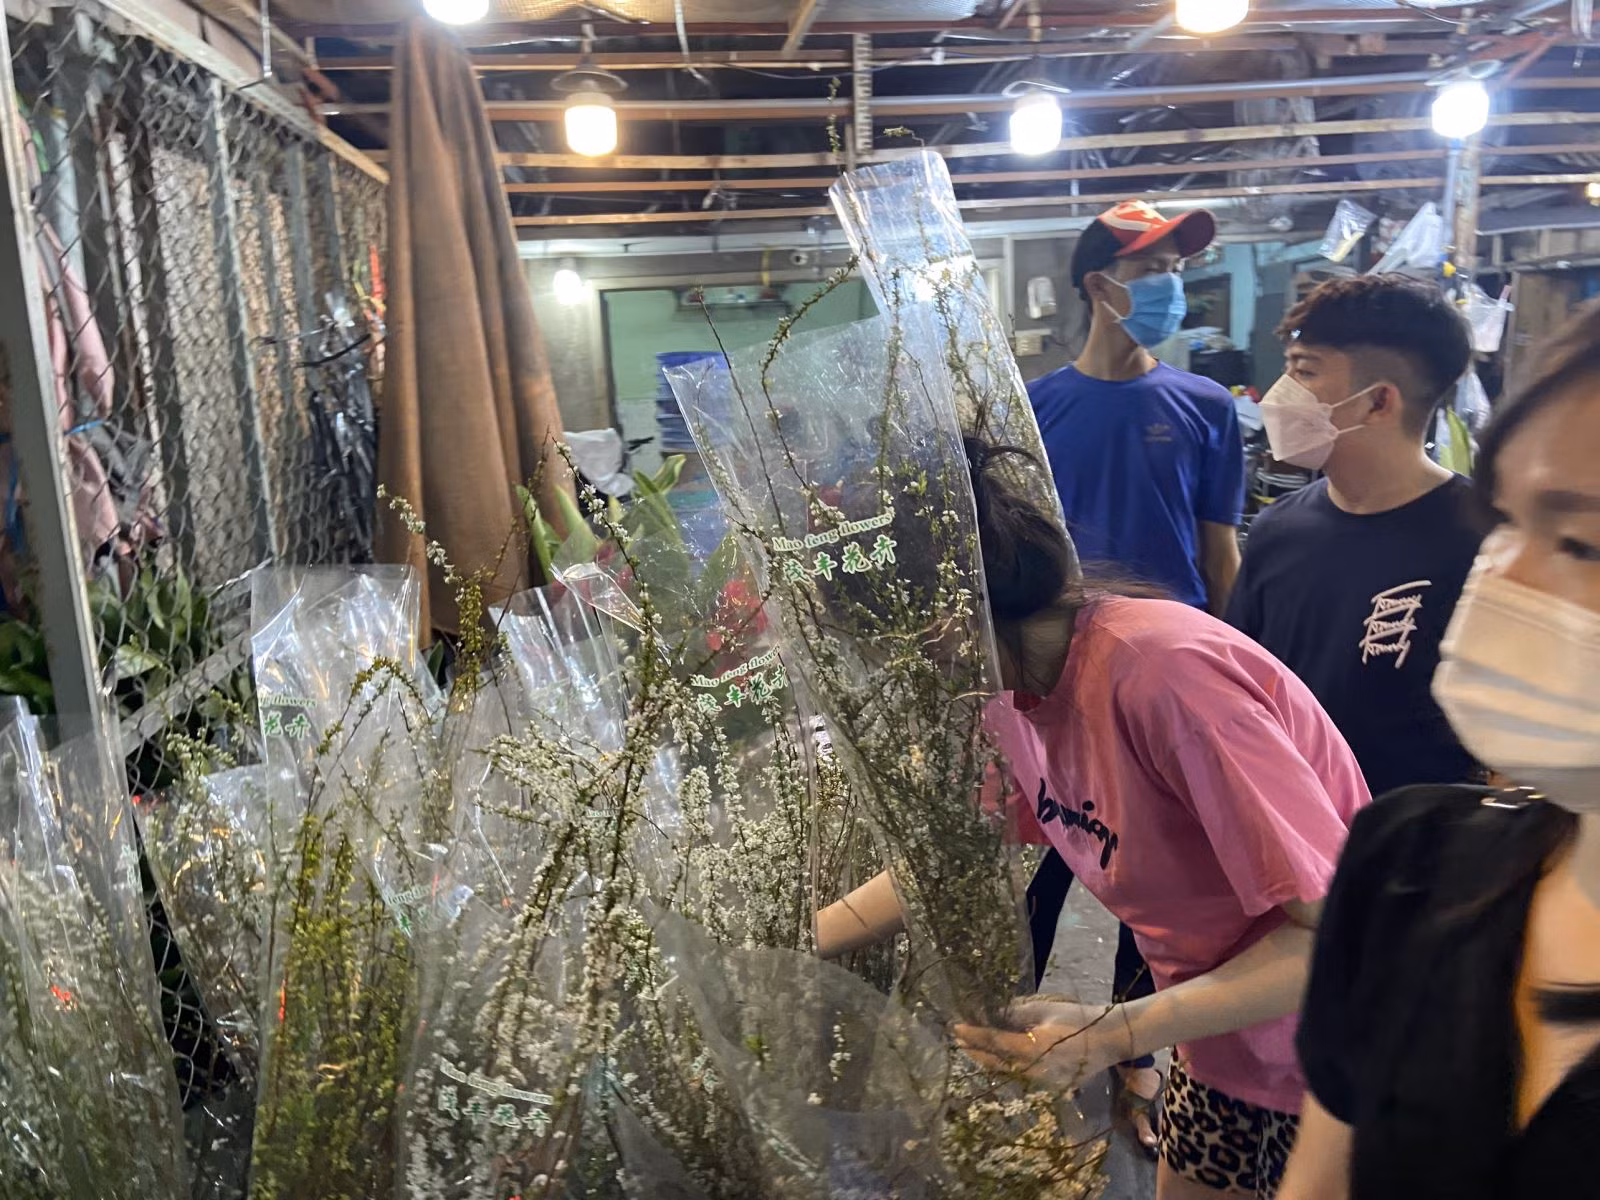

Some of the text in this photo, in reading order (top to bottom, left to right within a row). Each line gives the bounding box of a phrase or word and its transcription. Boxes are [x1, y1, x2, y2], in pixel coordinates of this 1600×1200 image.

[772, 512, 893, 551] Mao feng flowers
